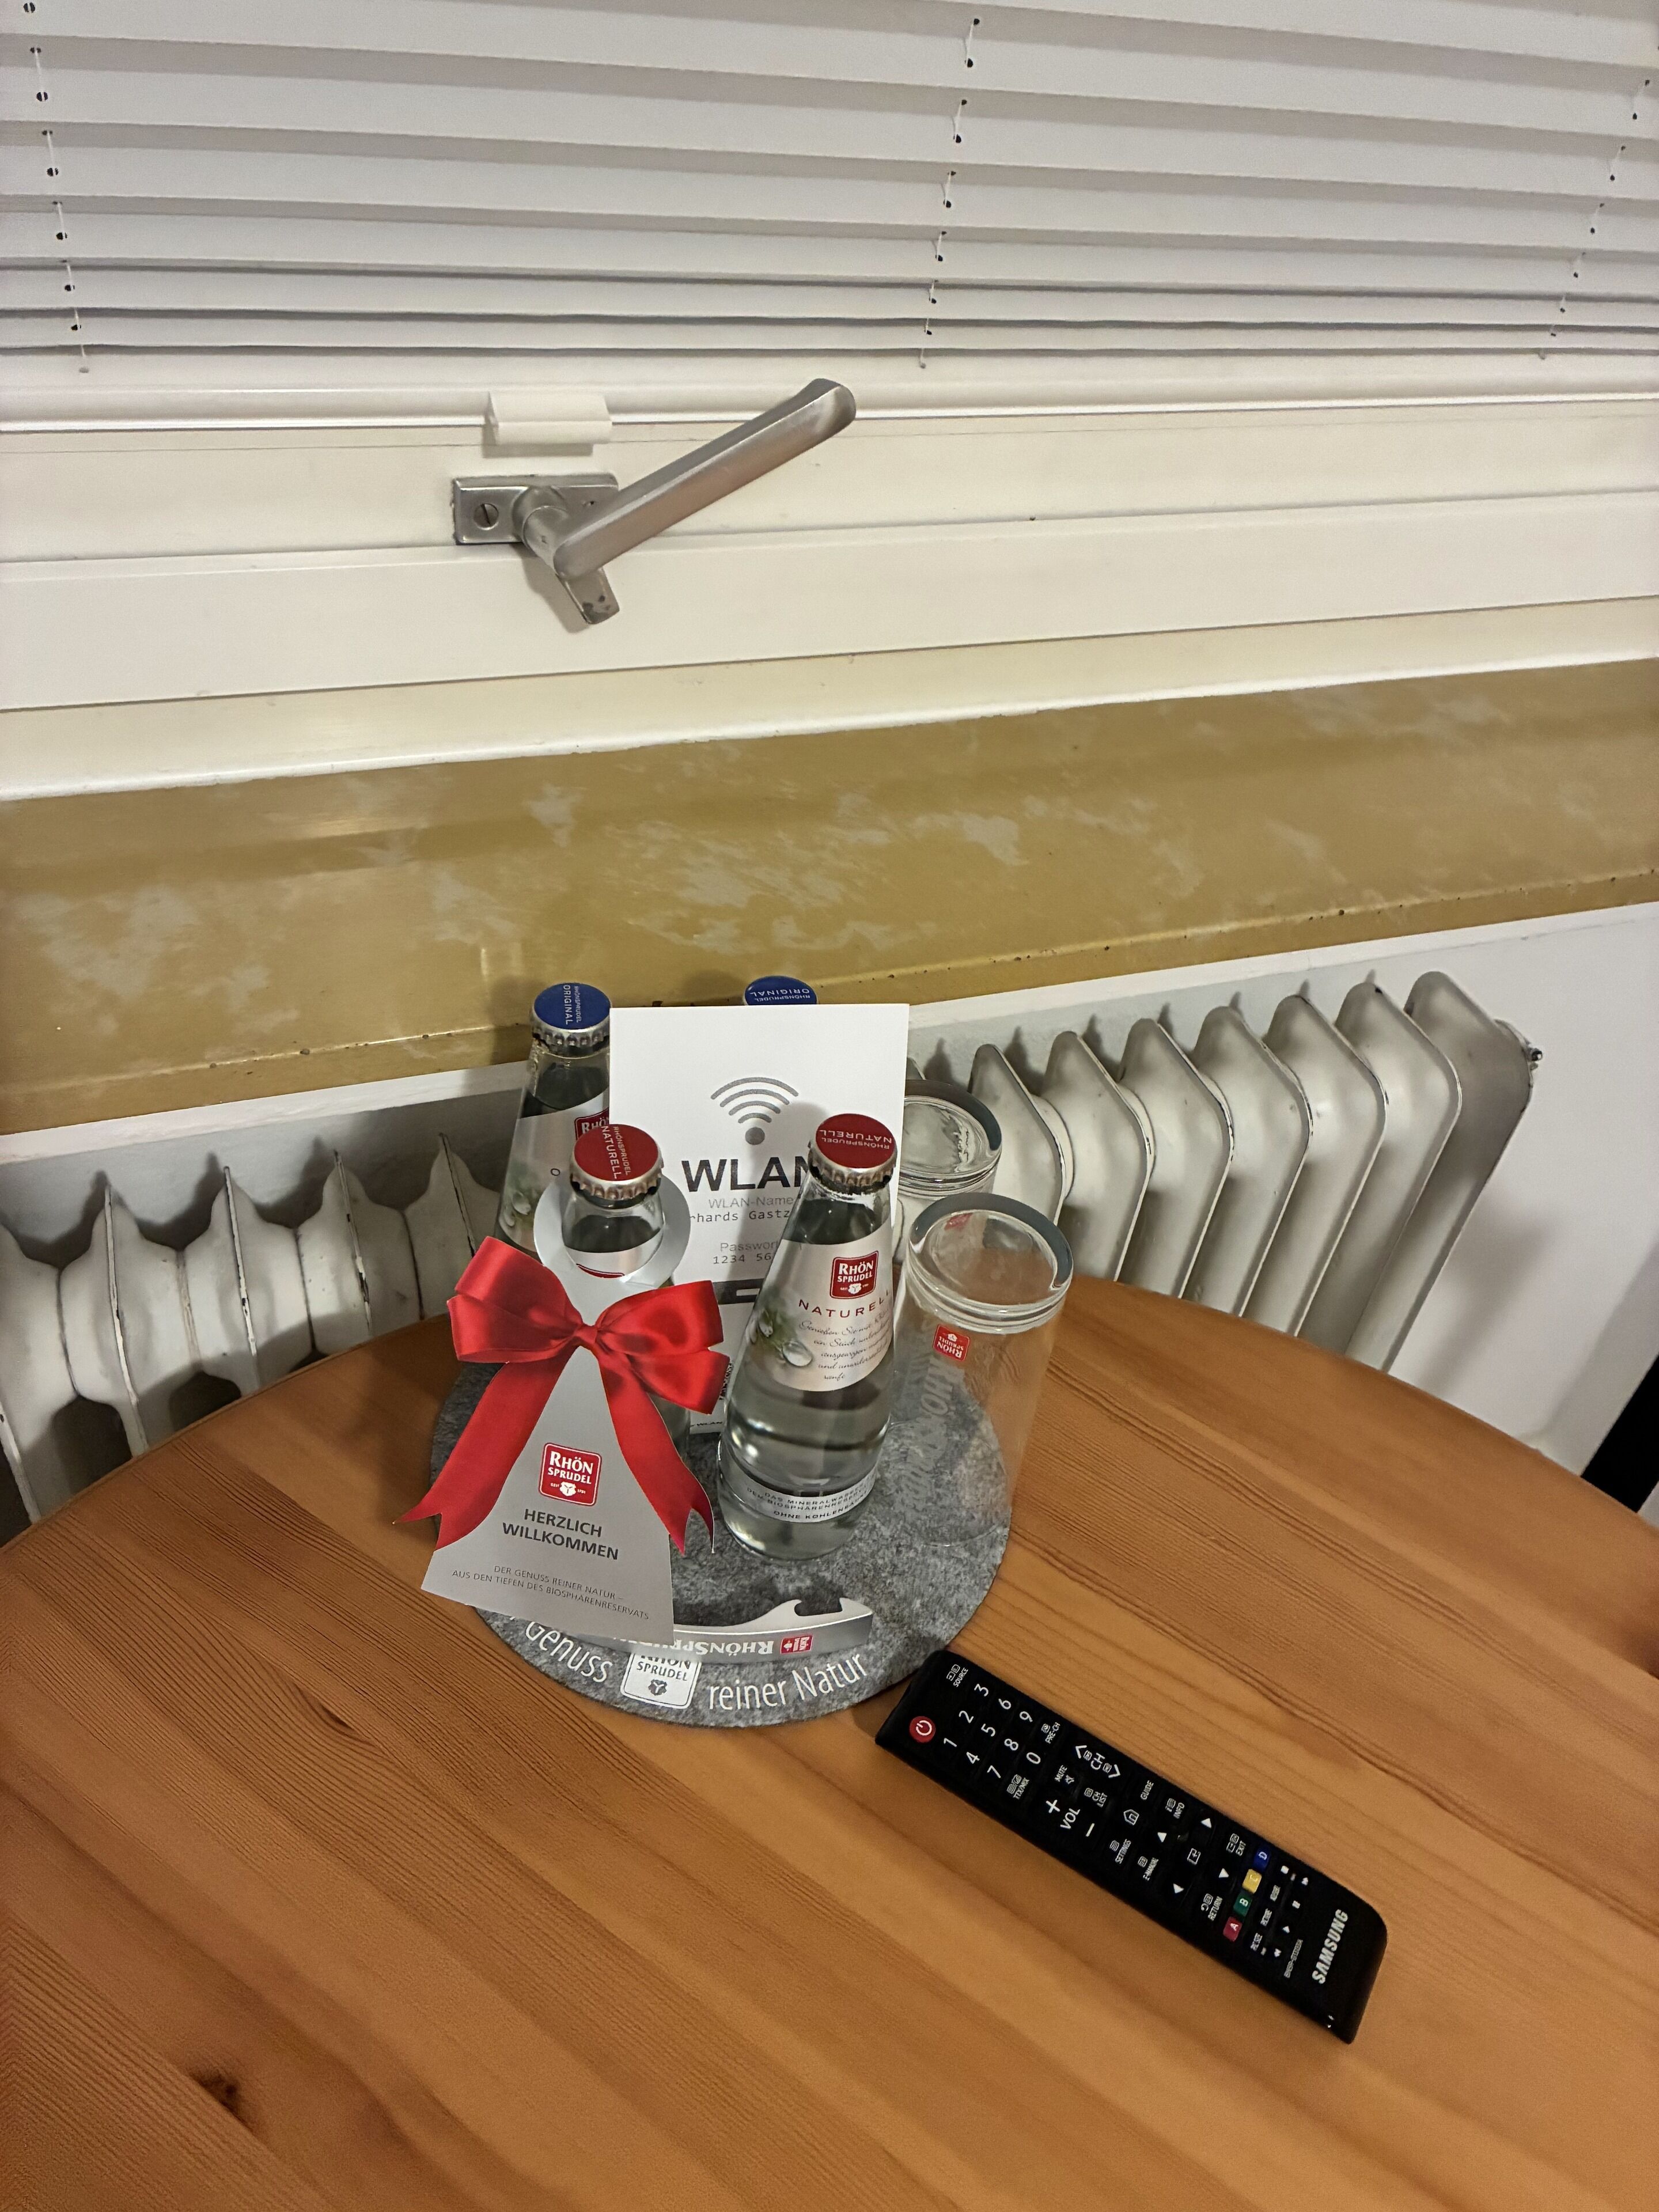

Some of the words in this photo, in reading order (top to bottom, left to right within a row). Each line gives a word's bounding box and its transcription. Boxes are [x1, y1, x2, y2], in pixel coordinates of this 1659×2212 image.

[749, 988, 809, 997] ORIGINAL
[563, 985, 573, 1025] ORIGINAL
[820, 1130, 892, 1143] NATURELL
[601, 1126, 618, 1179] NATURELL
[613, 1126, 631, 1176] RHÖNSPRUDEL
[709, 1196, 793, 1208] WLAN-Name
[713, 1254, 745, 1264] 1234
[756, 1252, 772, 1262] 56
[839, 1260, 874, 1275] RHÖN
[837, 1271, 873, 1283] SPRUDEL
[937, 1342, 963, 1359] RHÖN
[549, 1450, 593, 1475] RHÖN
[548, 1467, 592, 1484] SPRUDEL
[524, 1509, 602, 1537] HERZLICH
[774, 1510, 801, 1519] OHNE
[502, 1522, 619, 1560] WILLKOMMEN
[452, 1570, 471, 1579] AUS
[474, 1573, 492, 1582] DEN
[495, 1576, 524, 1588] TIEFEN
[527, 1582, 543, 1592] DES
[494, 1566, 511, 1575] DER
[514, 1569, 550, 1583] GENUSS
[552, 1577, 582, 1591] REINER
[585, 1585, 616, 1600] NATUR
[637, 1661, 688, 1681] SPRUDEL
[709, 1680, 788, 1710] reiner
[795, 1653, 868, 1701] Natur
[953, 1667, 968, 1687] SOURCE
[944, 1737, 957, 1747] 1
[959, 1710, 974, 1724] 2
[974, 1683, 989, 1696] 3
[966, 1751, 980, 1764] 4
[981, 1724, 995, 1737] 5
[998, 1698, 1012, 1710] 6
[987, 1765, 1001, 1779] 7
[1004, 1738, 1018, 1751] 8
[1019, 1711, 1033, 1722] 9
[1026, 1752, 1041, 1764] 0
[1090, 1752, 1105, 1770] CH
[1140, 1781, 1154, 1800] GUIDE
[1060, 1808, 1081, 1830] VOL
[1173, 1802, 1185, 1819] INFO
[1230, 1923, 1238, 1931] A
[1240, 1898, 1248, 1907] B
[1258, 1851, 1267, 1860] D
[1207, 1896, 1223, 1921] RETURN
[1312, 1908, 1349, 1984] SAMSUNG
